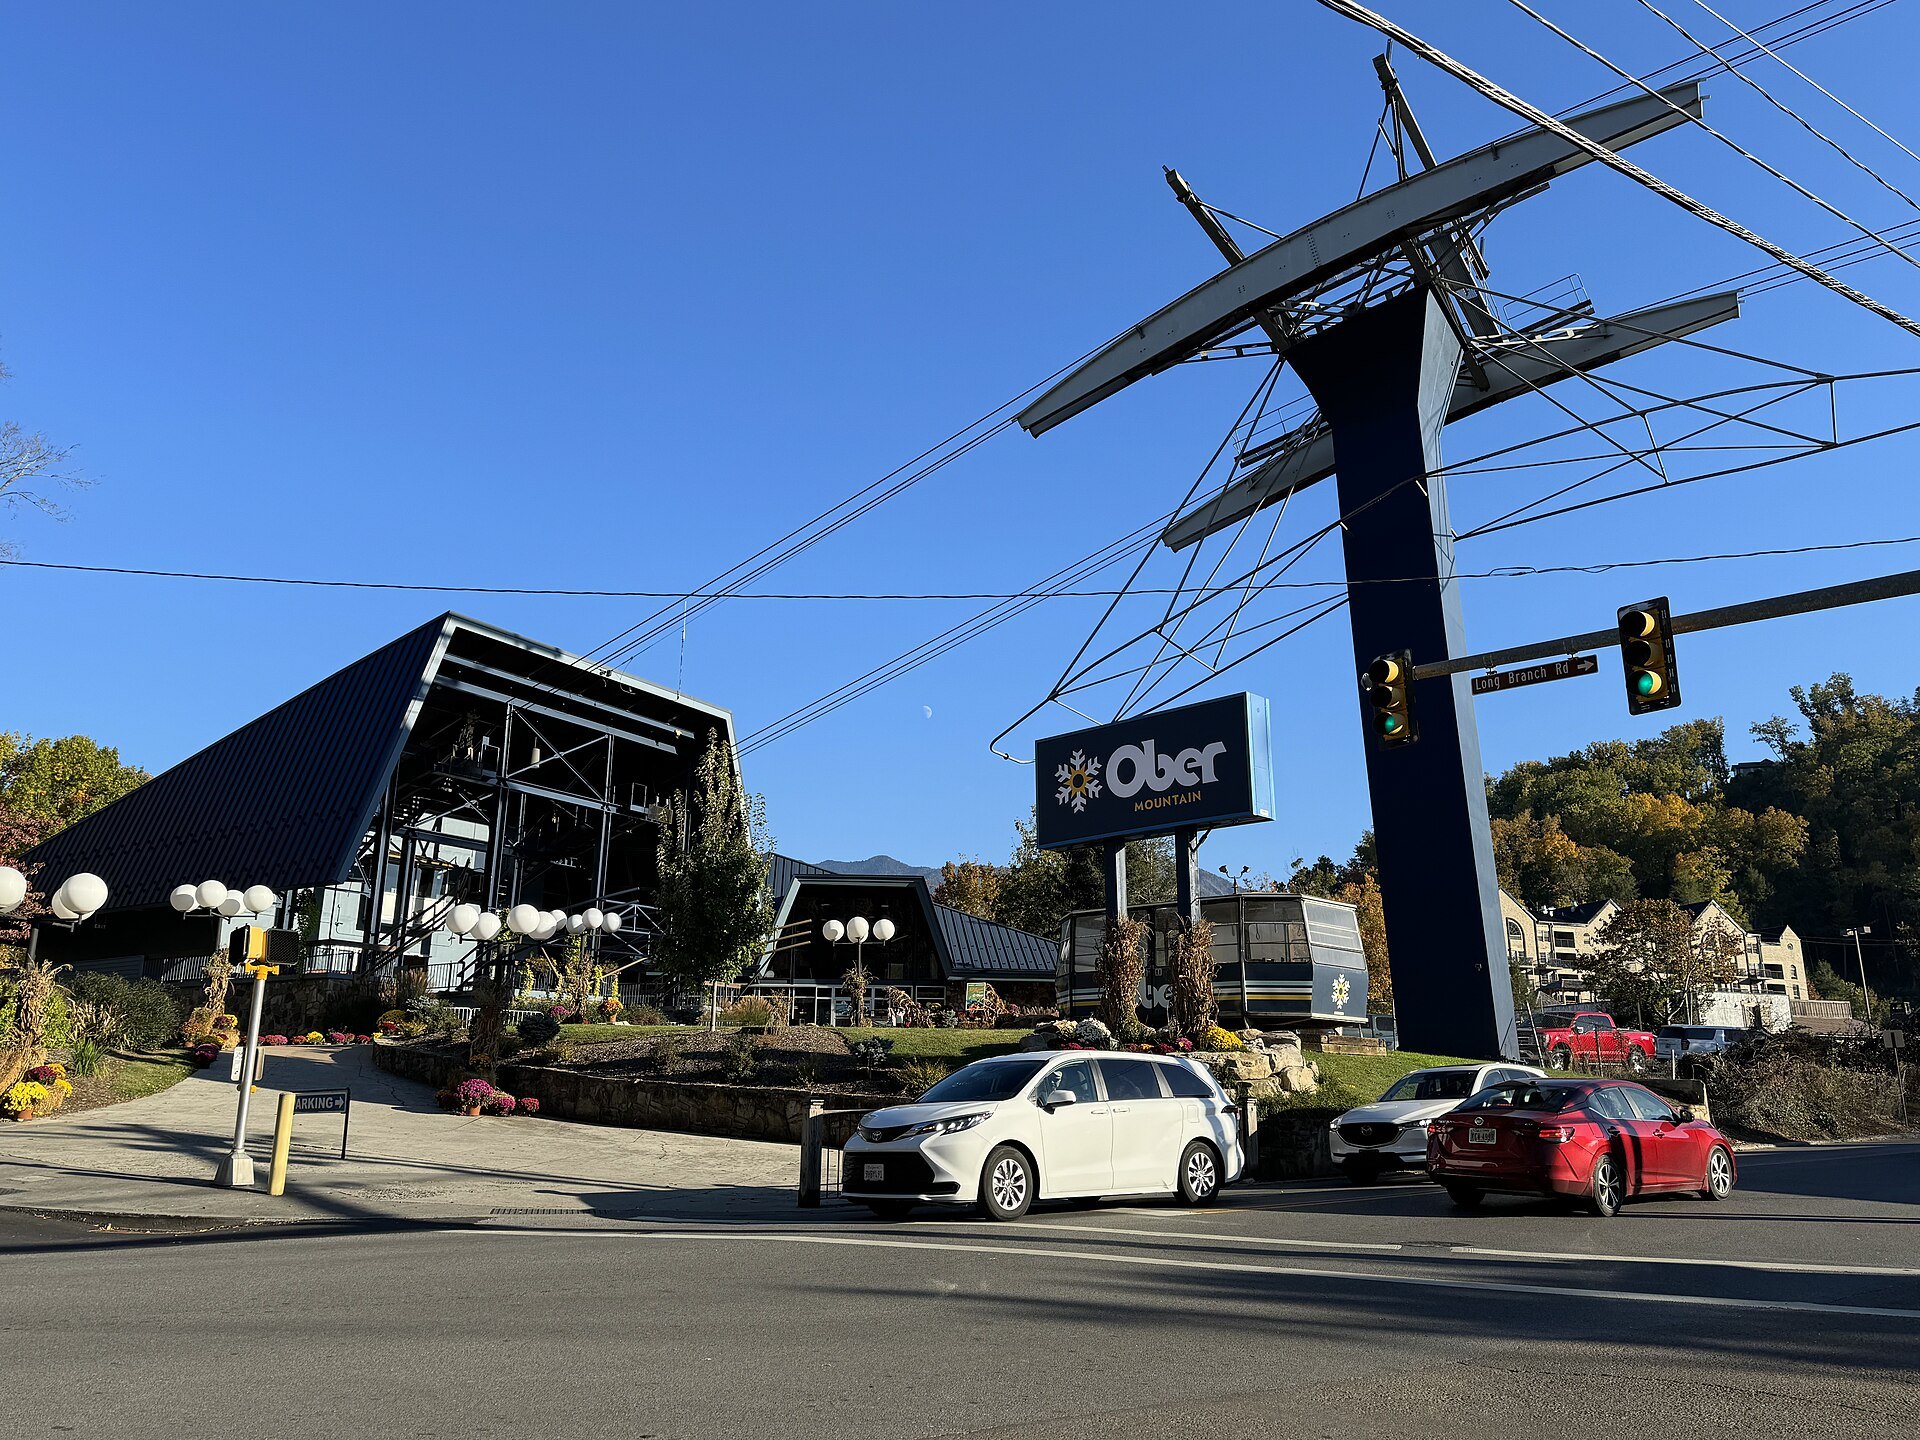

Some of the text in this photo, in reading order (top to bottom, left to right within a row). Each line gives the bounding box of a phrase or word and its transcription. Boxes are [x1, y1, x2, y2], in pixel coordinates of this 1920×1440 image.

[1475, 661, 1569, 691] Long Branch Rd
[1105, 738, 1227, 798] Ober
[1134, 790, 1202, 812] MOUNTAIN
[295, 1096, 334, 1110] ARKING
